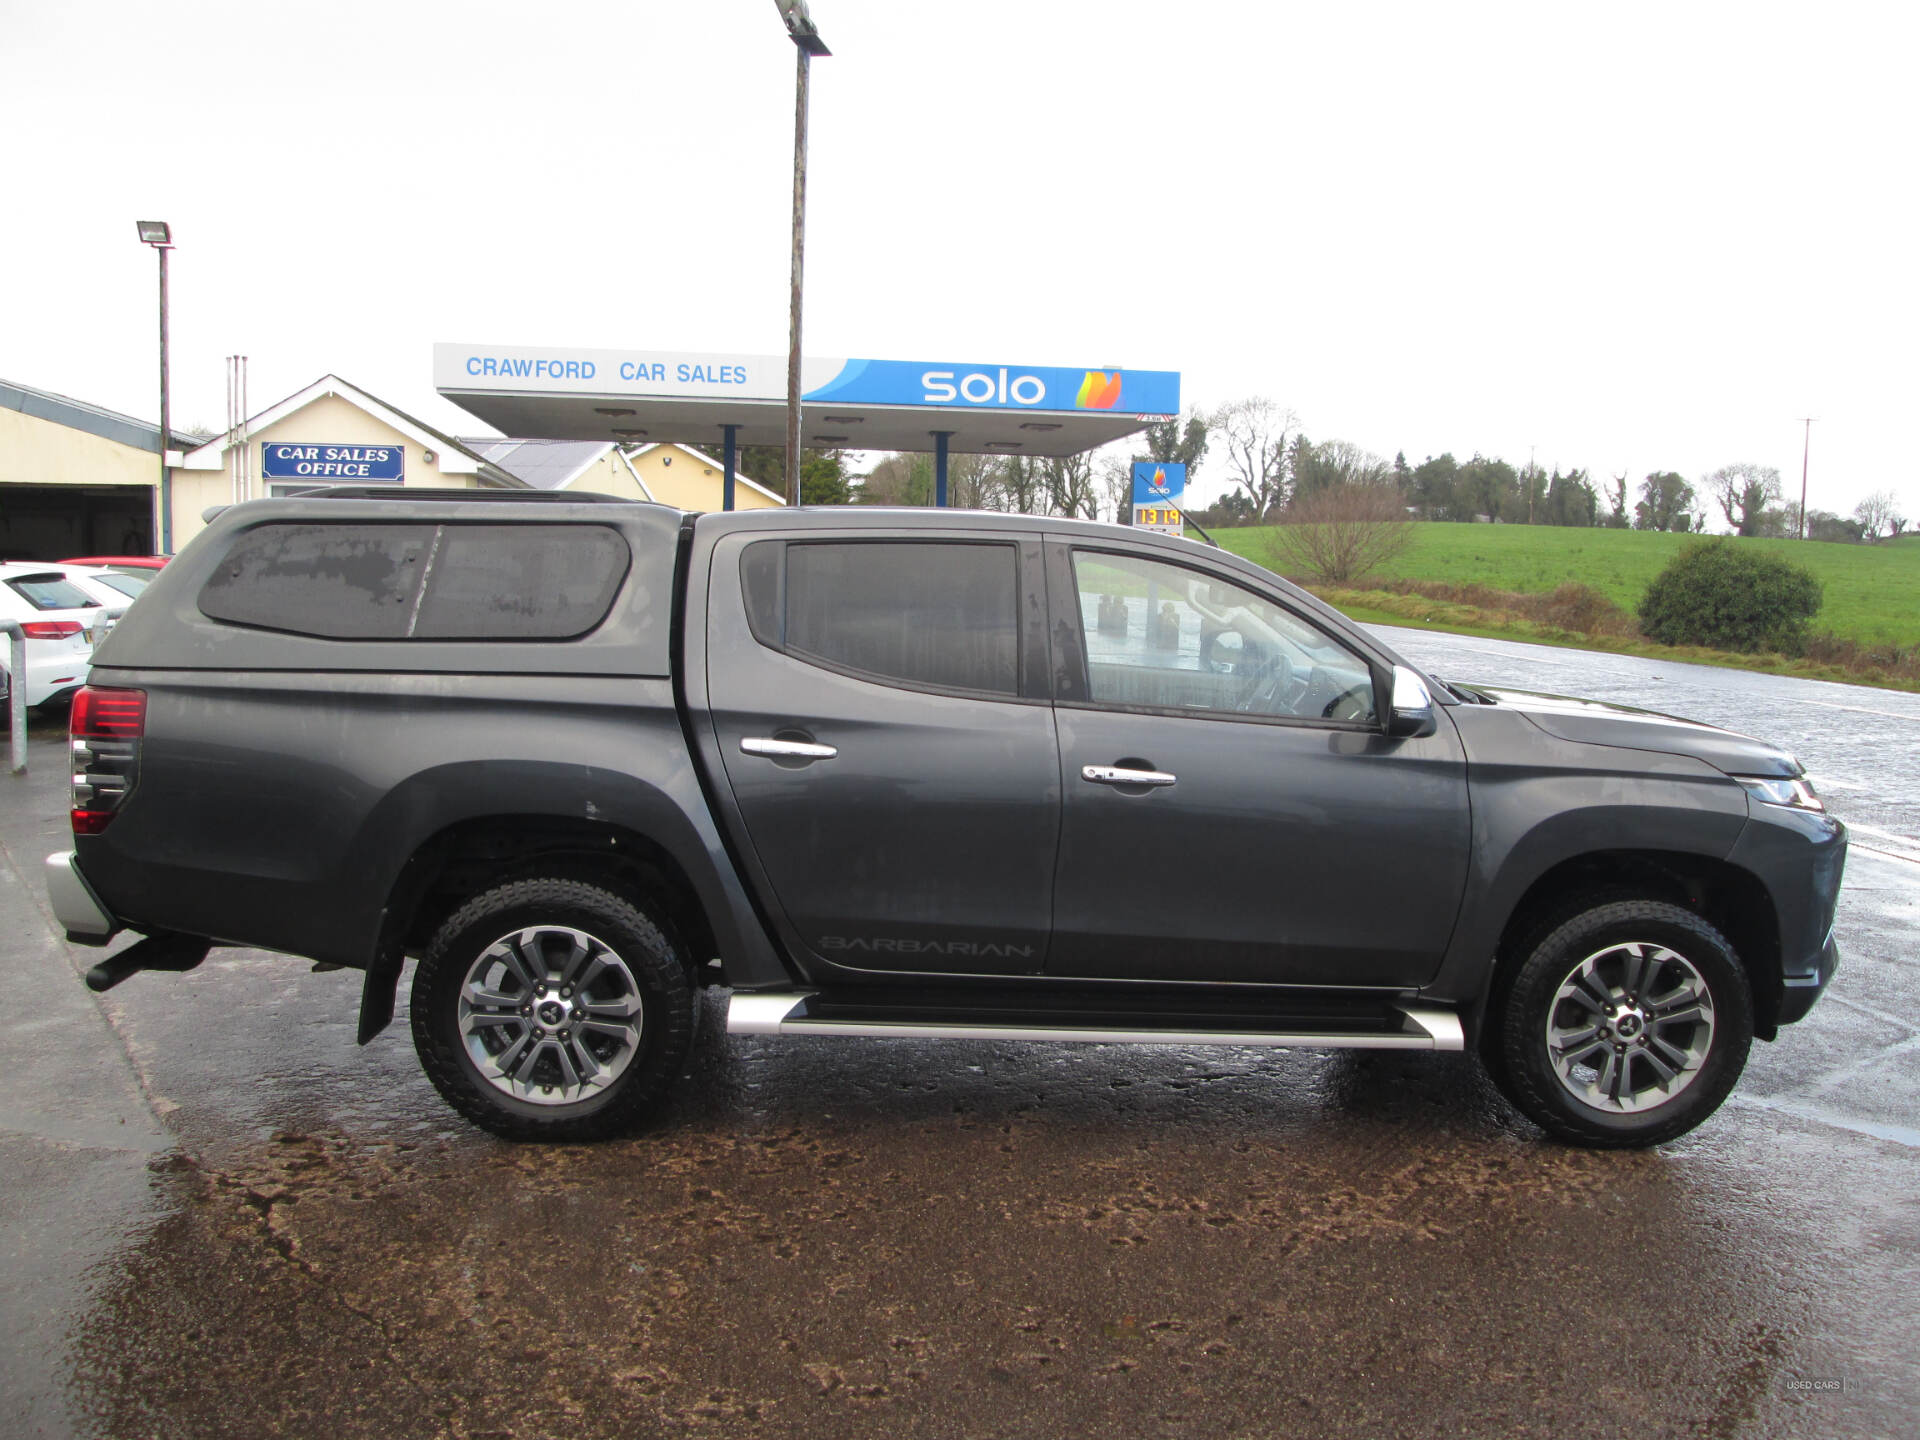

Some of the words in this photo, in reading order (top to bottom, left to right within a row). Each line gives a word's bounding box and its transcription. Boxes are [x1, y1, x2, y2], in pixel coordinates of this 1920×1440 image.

[466, 357, 596, 379] CRAWFORD
[619, 362, 665, 381] CAR
[677, 364, 747, 384] SALES
[921, 368, 1046, 405] solo
[278, 447, 318, 460] CAR
[326, 449, 389, 462] SALES
[297, 462, 370, 476] OFFICE
[818, 940, 1035, 958] BARBARIAN
